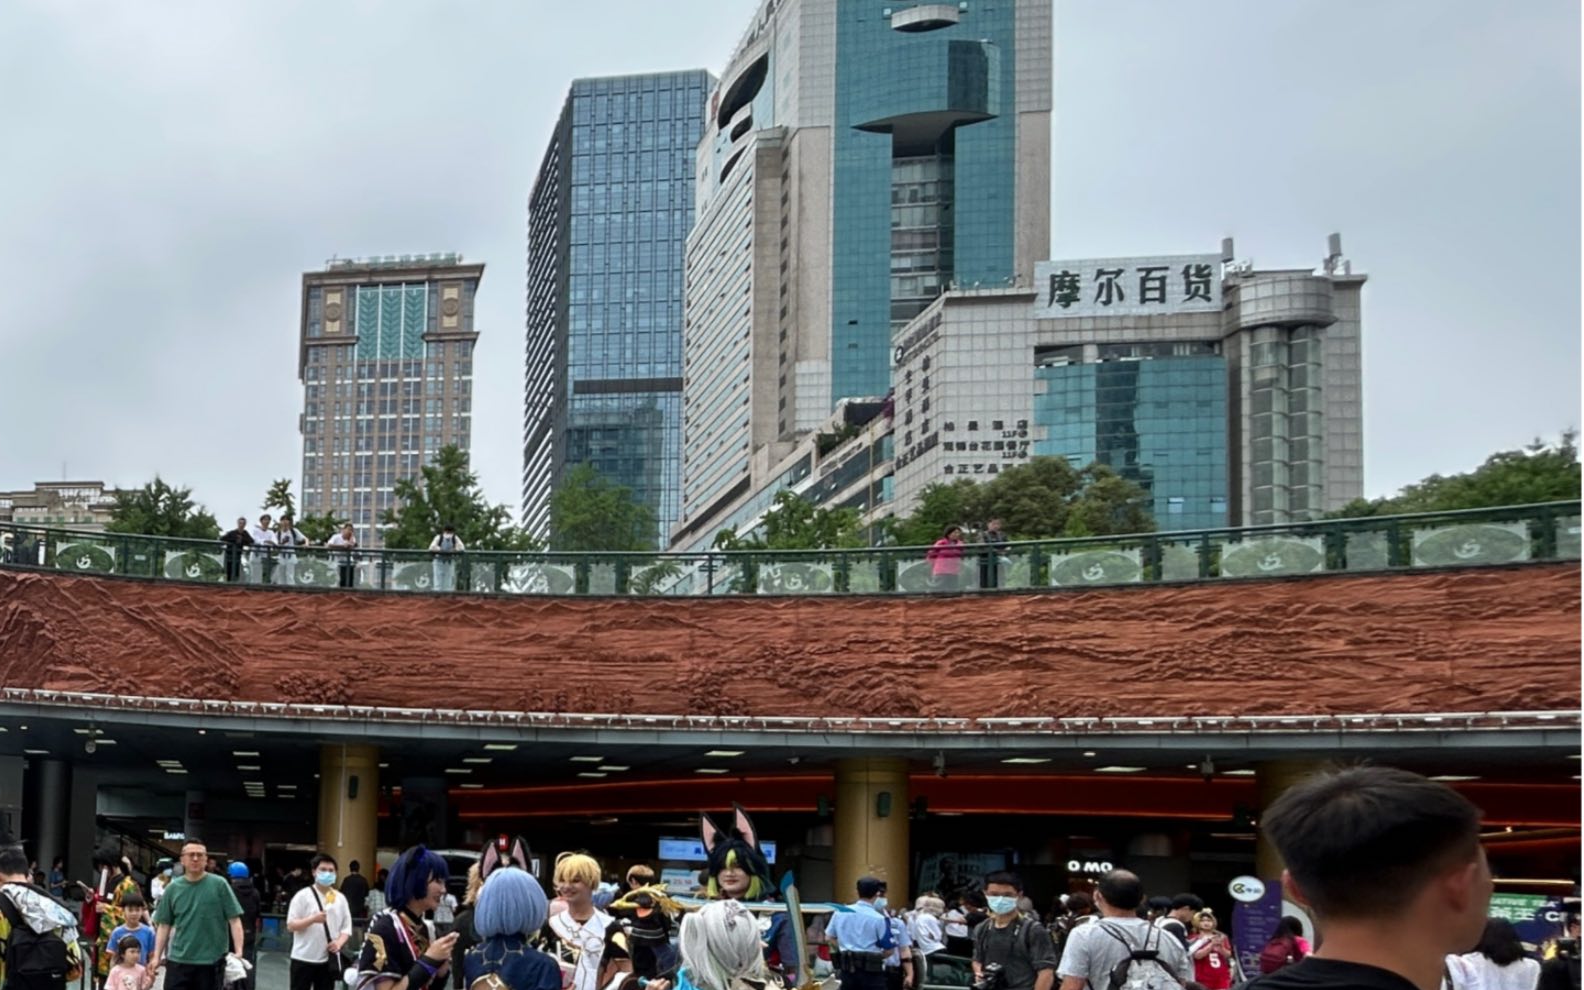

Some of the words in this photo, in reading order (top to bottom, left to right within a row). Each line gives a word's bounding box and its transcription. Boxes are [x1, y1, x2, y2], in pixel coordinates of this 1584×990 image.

[1048, 263, 1213, 309] 摩尔百货
[1209, 953, 1221, 968] 5
